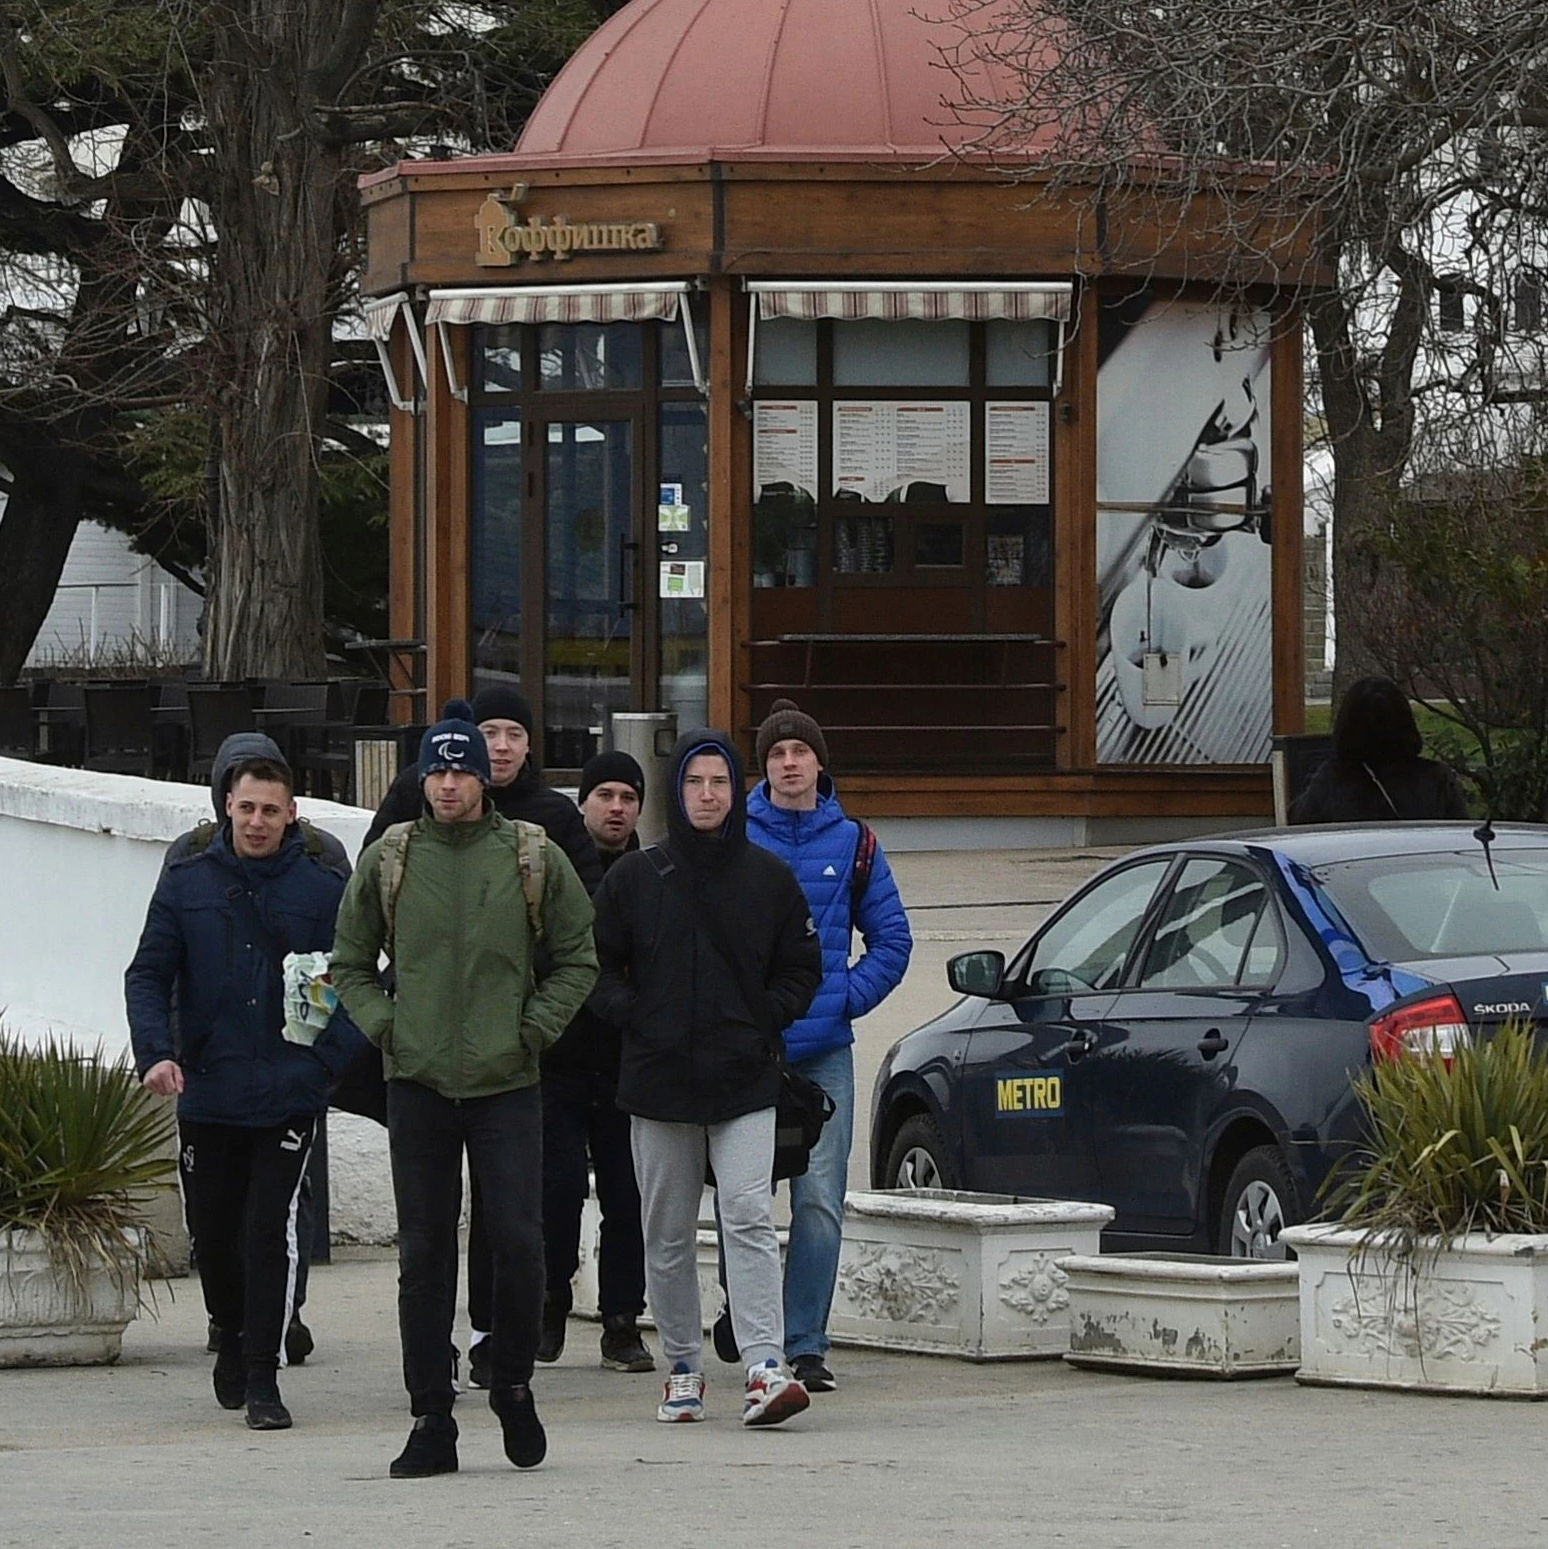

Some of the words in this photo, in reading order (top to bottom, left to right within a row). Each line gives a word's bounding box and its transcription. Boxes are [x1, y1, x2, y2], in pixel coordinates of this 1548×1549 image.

[479, 215, 659, 263] Коффишка
[1474, 1001, 1531, 1015] ŠKODA
[997, 1076, 1061, 1112] METRO
